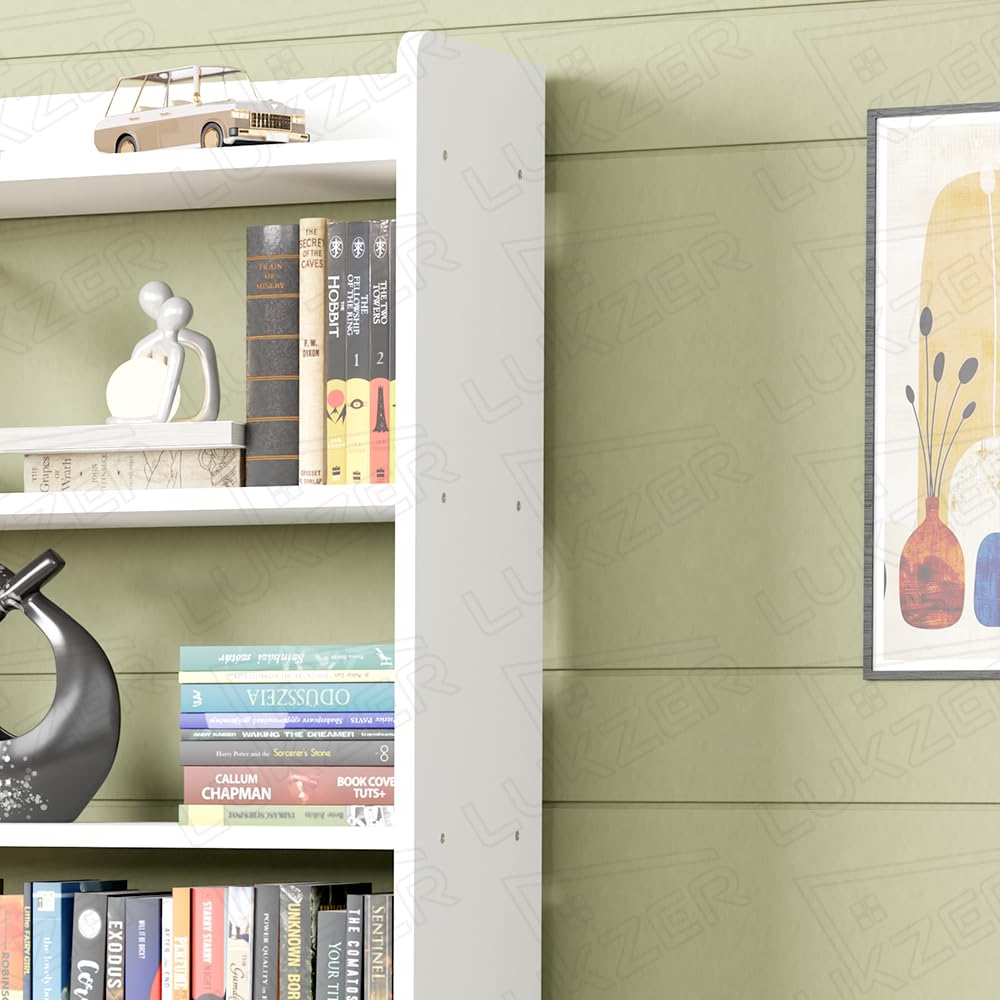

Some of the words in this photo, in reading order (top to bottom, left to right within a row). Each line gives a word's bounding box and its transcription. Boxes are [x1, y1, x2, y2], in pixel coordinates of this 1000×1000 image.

[301, 260, 324, 268] CAVES
[347, 274, 354, 287] OF
[380, 280, 388, 300] THE
[328, 276, 340, 338] HOBBIT
[372, 282, 380, 324] TOWERS
[380, 302, 388, 324] TWO
[354, 353, 358, 366] 1
[376, 352, 384, 364] 2
[40, 456, 50, 492] Grapes
[62, 458, 72, 490] Wrath
[273, 748, 308, 757] Sorcerer's
[310, 748, 331, 757] Stone
[215, 774, 258, 784] CALLUM
[337, 777, 368, 787] BOOK
[201, 787, 272, 800] CHAPMAN
[353, 789, 386, 798] TUTS+
[347, 909, 360, 932] THE
[287, 903, 301, 966] UNKNOWN
[371, 906, 385, 983] SENTINEL
[107, 921, 123, 988] EXODUS
[327, 942, 342, 979] YOUR
